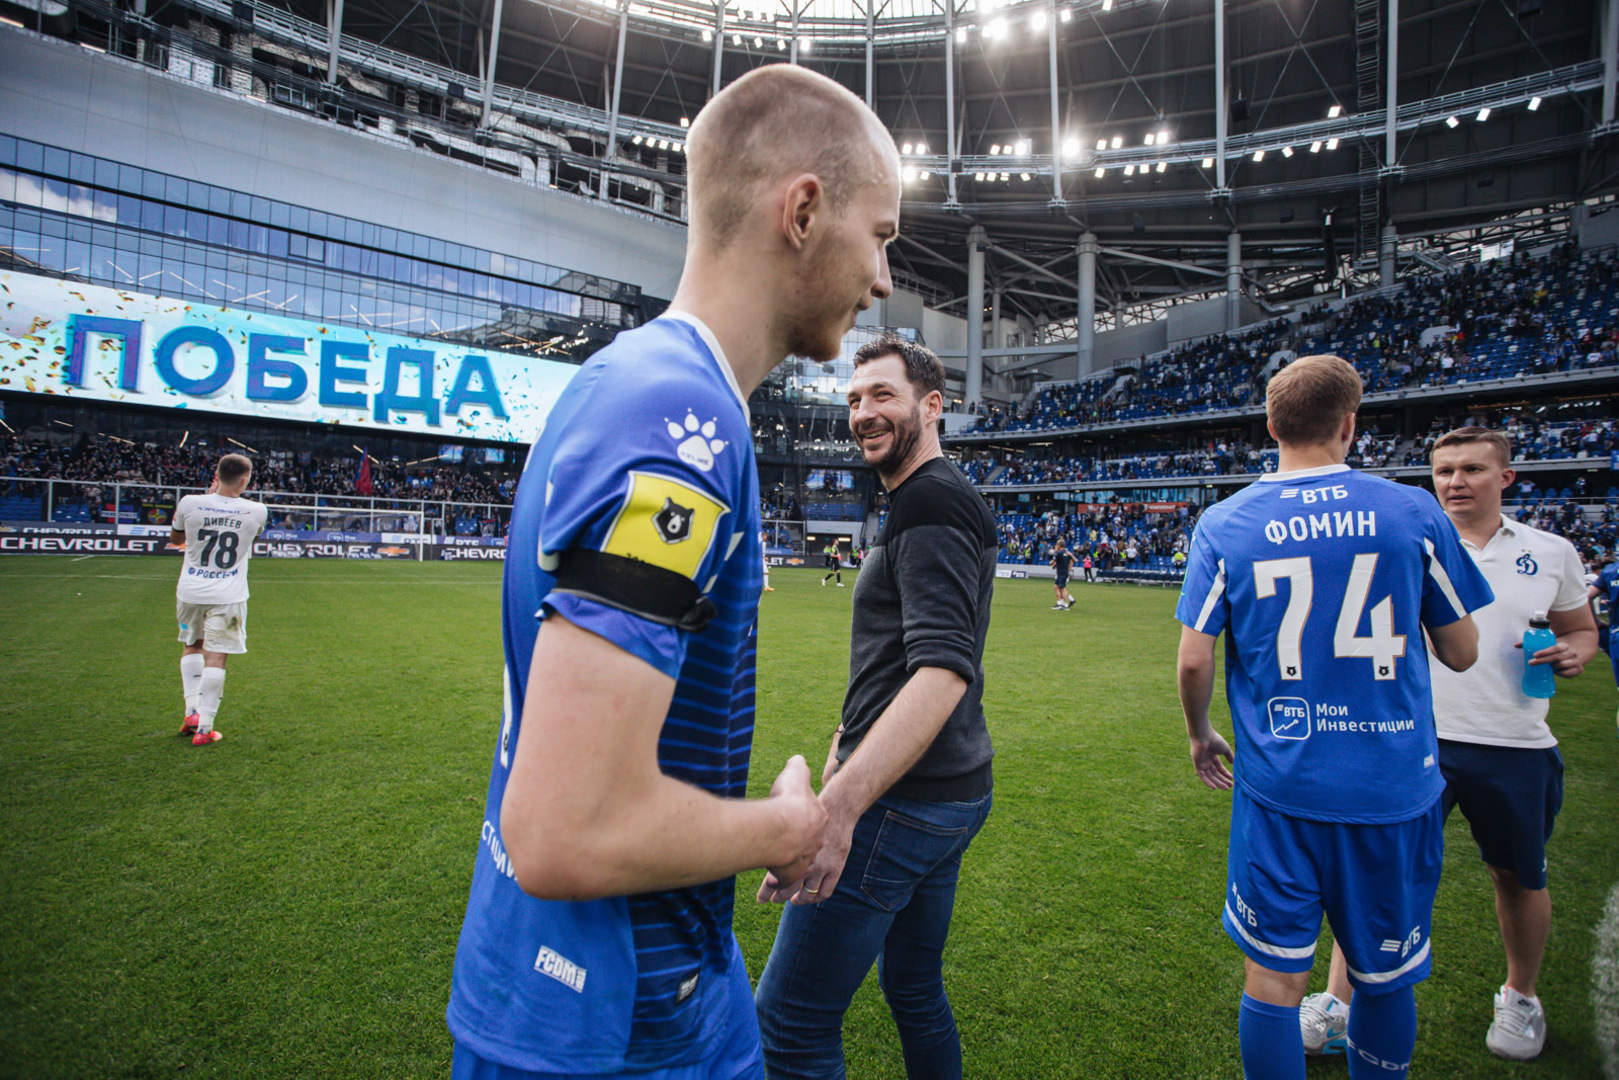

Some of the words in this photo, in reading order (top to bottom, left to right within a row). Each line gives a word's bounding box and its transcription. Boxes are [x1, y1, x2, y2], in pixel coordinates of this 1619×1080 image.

[65, 313, 507, 427] ПОБЕДА
[1301, 484, 1349, 504] ВТБ
[203, 517, 242, 529] ДИВЕЕВ
[1264, 510, 1376, 545] ФОМИН
[0, 537, 159, 551] CHEVROLET
[197, 528, 239, 570] 78
[1253, 552, 1407, 681] 74
[1284, 706, 1305, 718] ВТБ
[1315, 703, 1349, 717] Мои
[1316, 718, 1415, 733] Инвестиции
[1236, 893, 1258, 927] ВТБ
[1401, 925, 1421, 958] ВТБ
